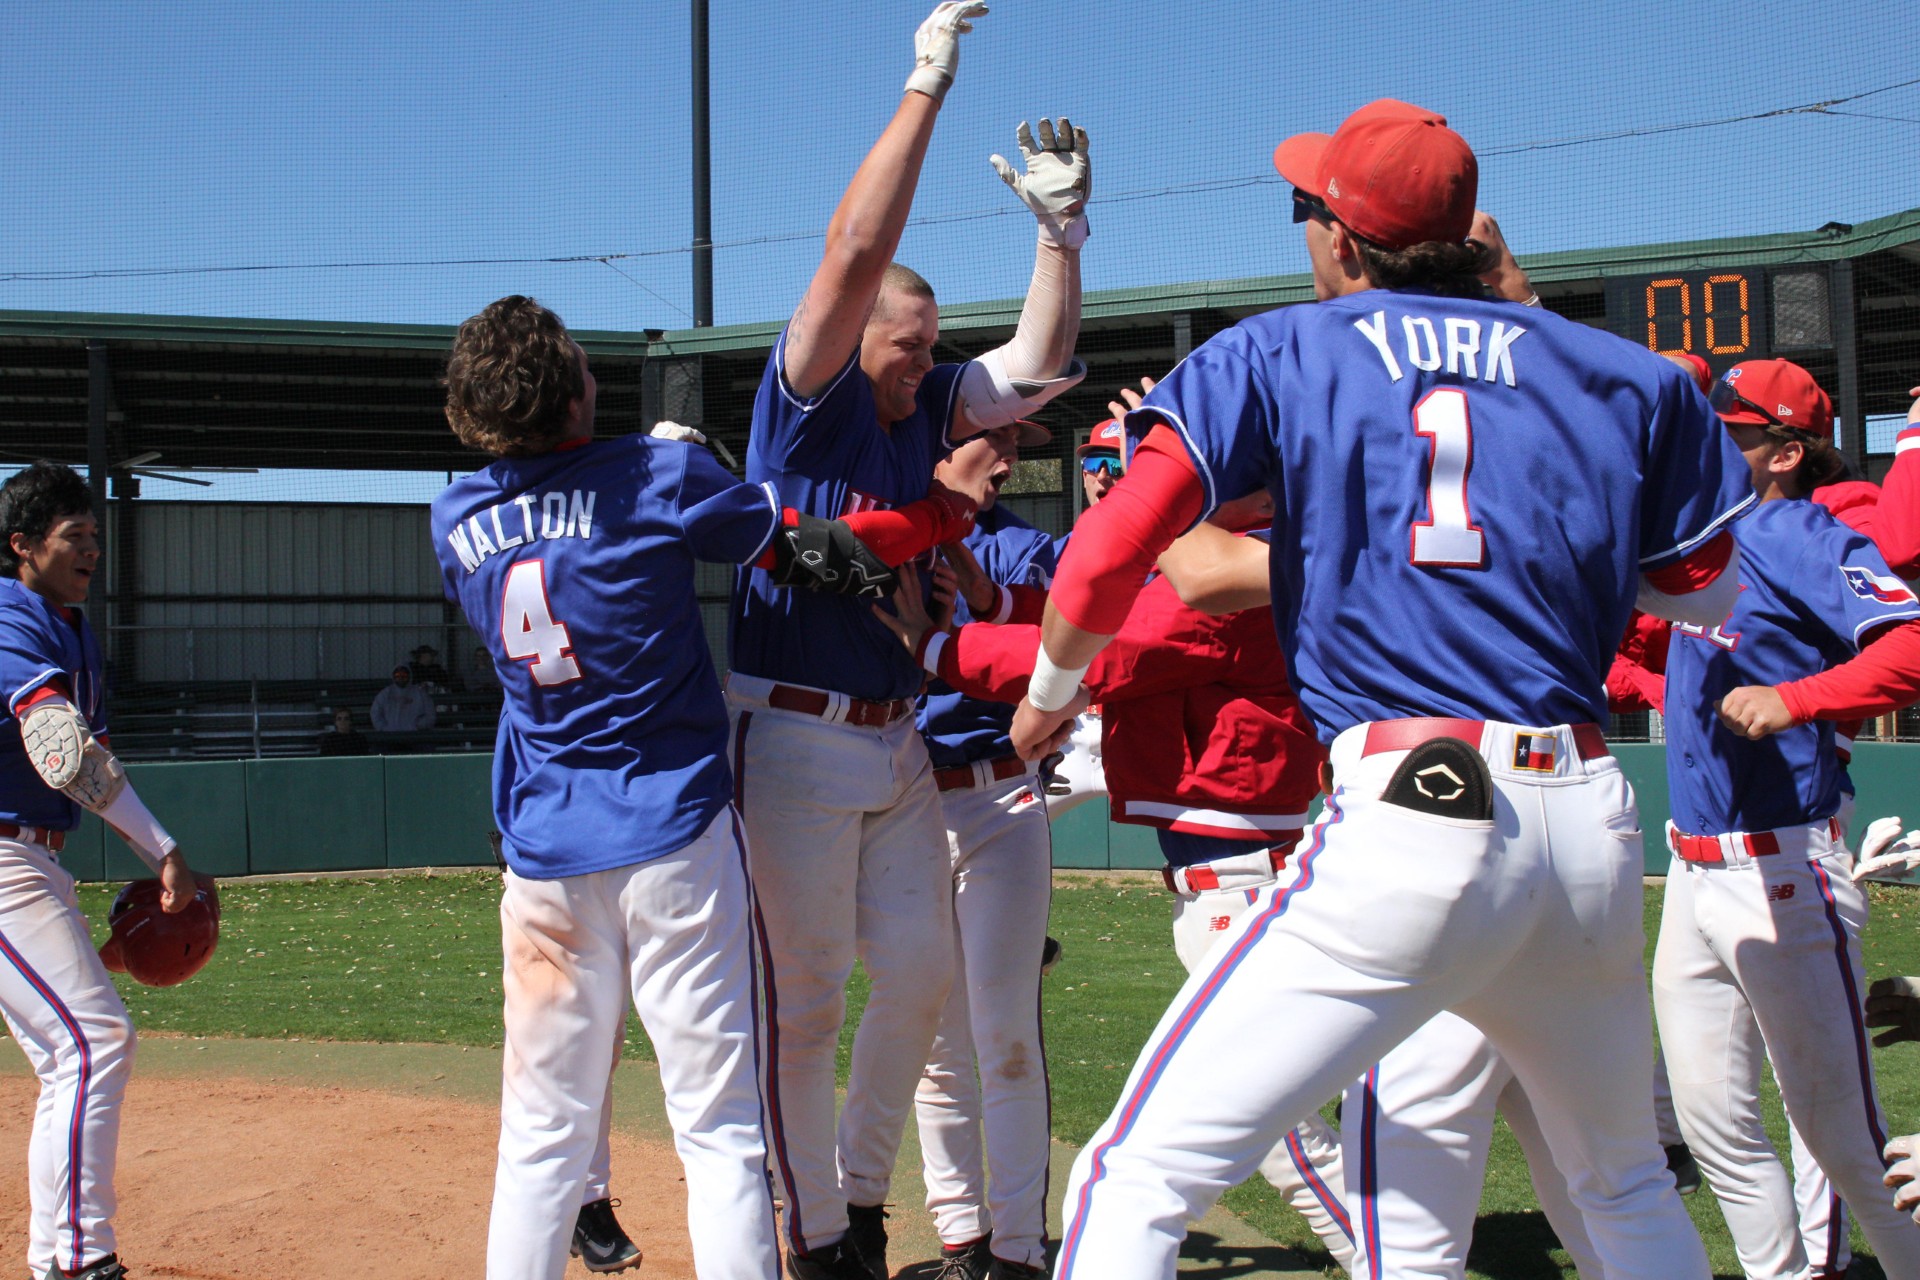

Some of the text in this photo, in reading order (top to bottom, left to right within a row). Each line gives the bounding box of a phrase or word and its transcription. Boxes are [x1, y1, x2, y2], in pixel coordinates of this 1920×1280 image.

[1354, 310, 1527, 387] YORK
[1646, 274, 1750, 356] 00
[1410, 387, 1485, 567] 1
[447, 489, 596, 575] WALTON
[499, 558, 585, 687] 4
